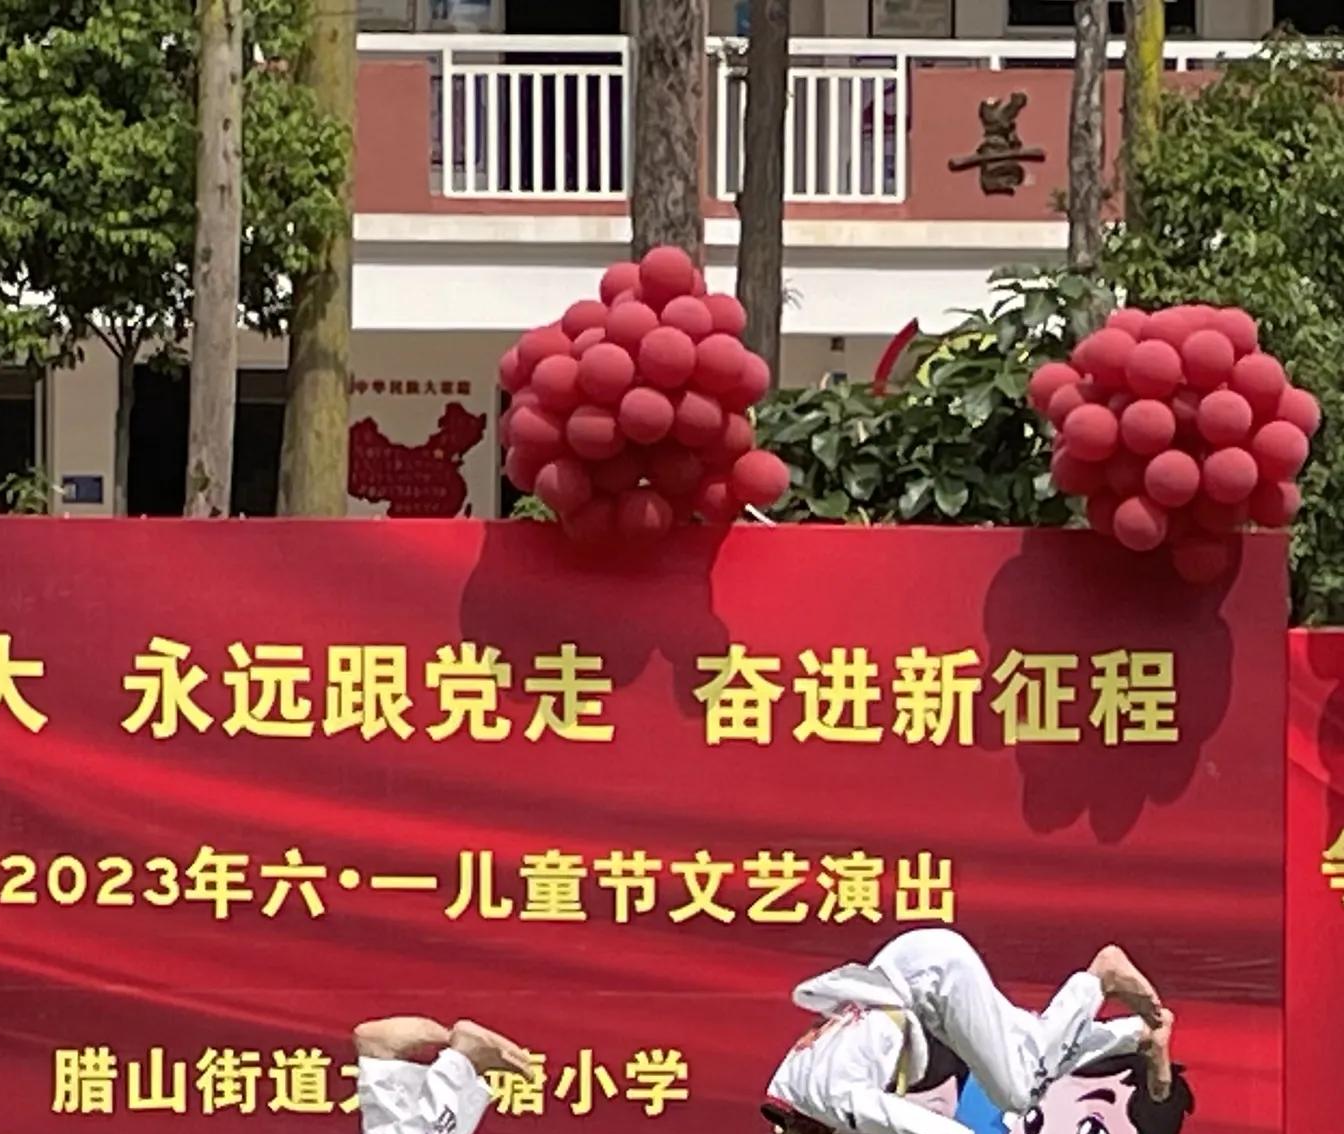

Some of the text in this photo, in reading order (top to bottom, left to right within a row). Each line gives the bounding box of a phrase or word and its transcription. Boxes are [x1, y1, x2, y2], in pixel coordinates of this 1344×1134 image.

[122, 636, 616, 742] 永远跟党走
[694, 643, 1181, 746] 奋进新征程
[52, 1047, 689, 1116] 腊山街道塘小学
